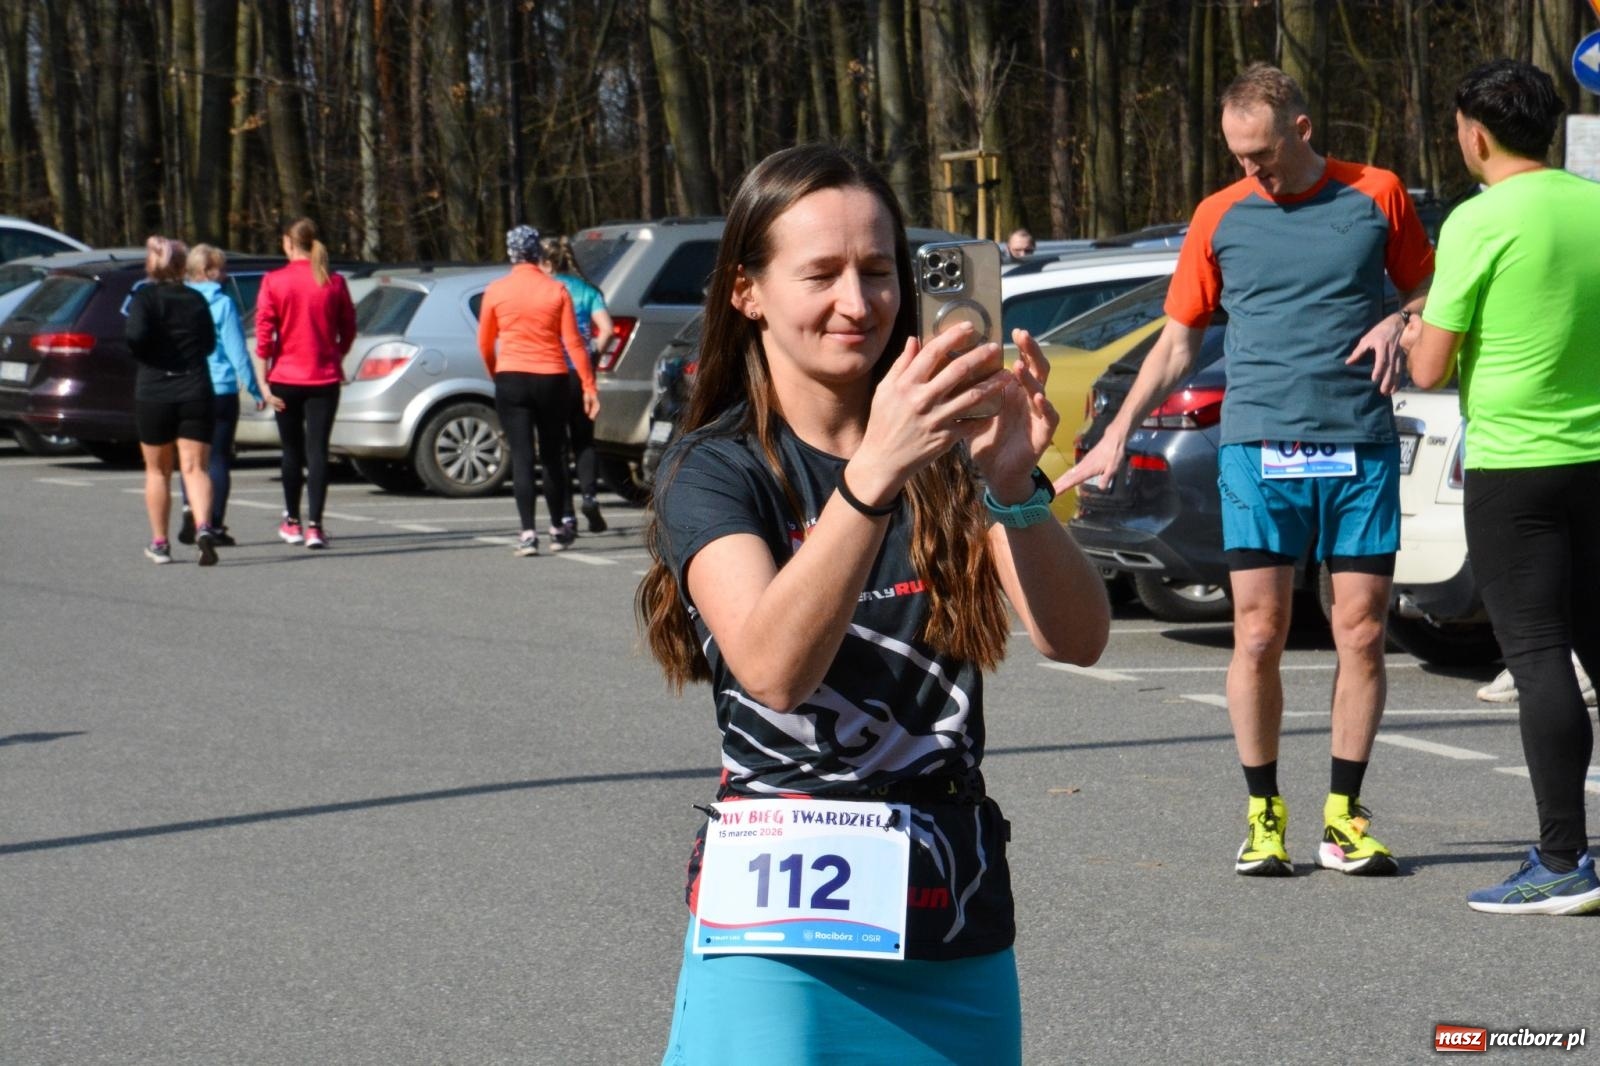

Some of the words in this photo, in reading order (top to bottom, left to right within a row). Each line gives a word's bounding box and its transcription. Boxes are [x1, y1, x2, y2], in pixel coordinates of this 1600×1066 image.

[720, 811, 744, 825] XIV
[749, 809, 784, 825] BIEG
[792, 810, 887, 829] TWARDZIEL
[718, 830, 727, 838] 15
[728, 830, 757, 838] marzec
[759, 828, 783, 837] 2026
[748, 853, 851, 911] 112
